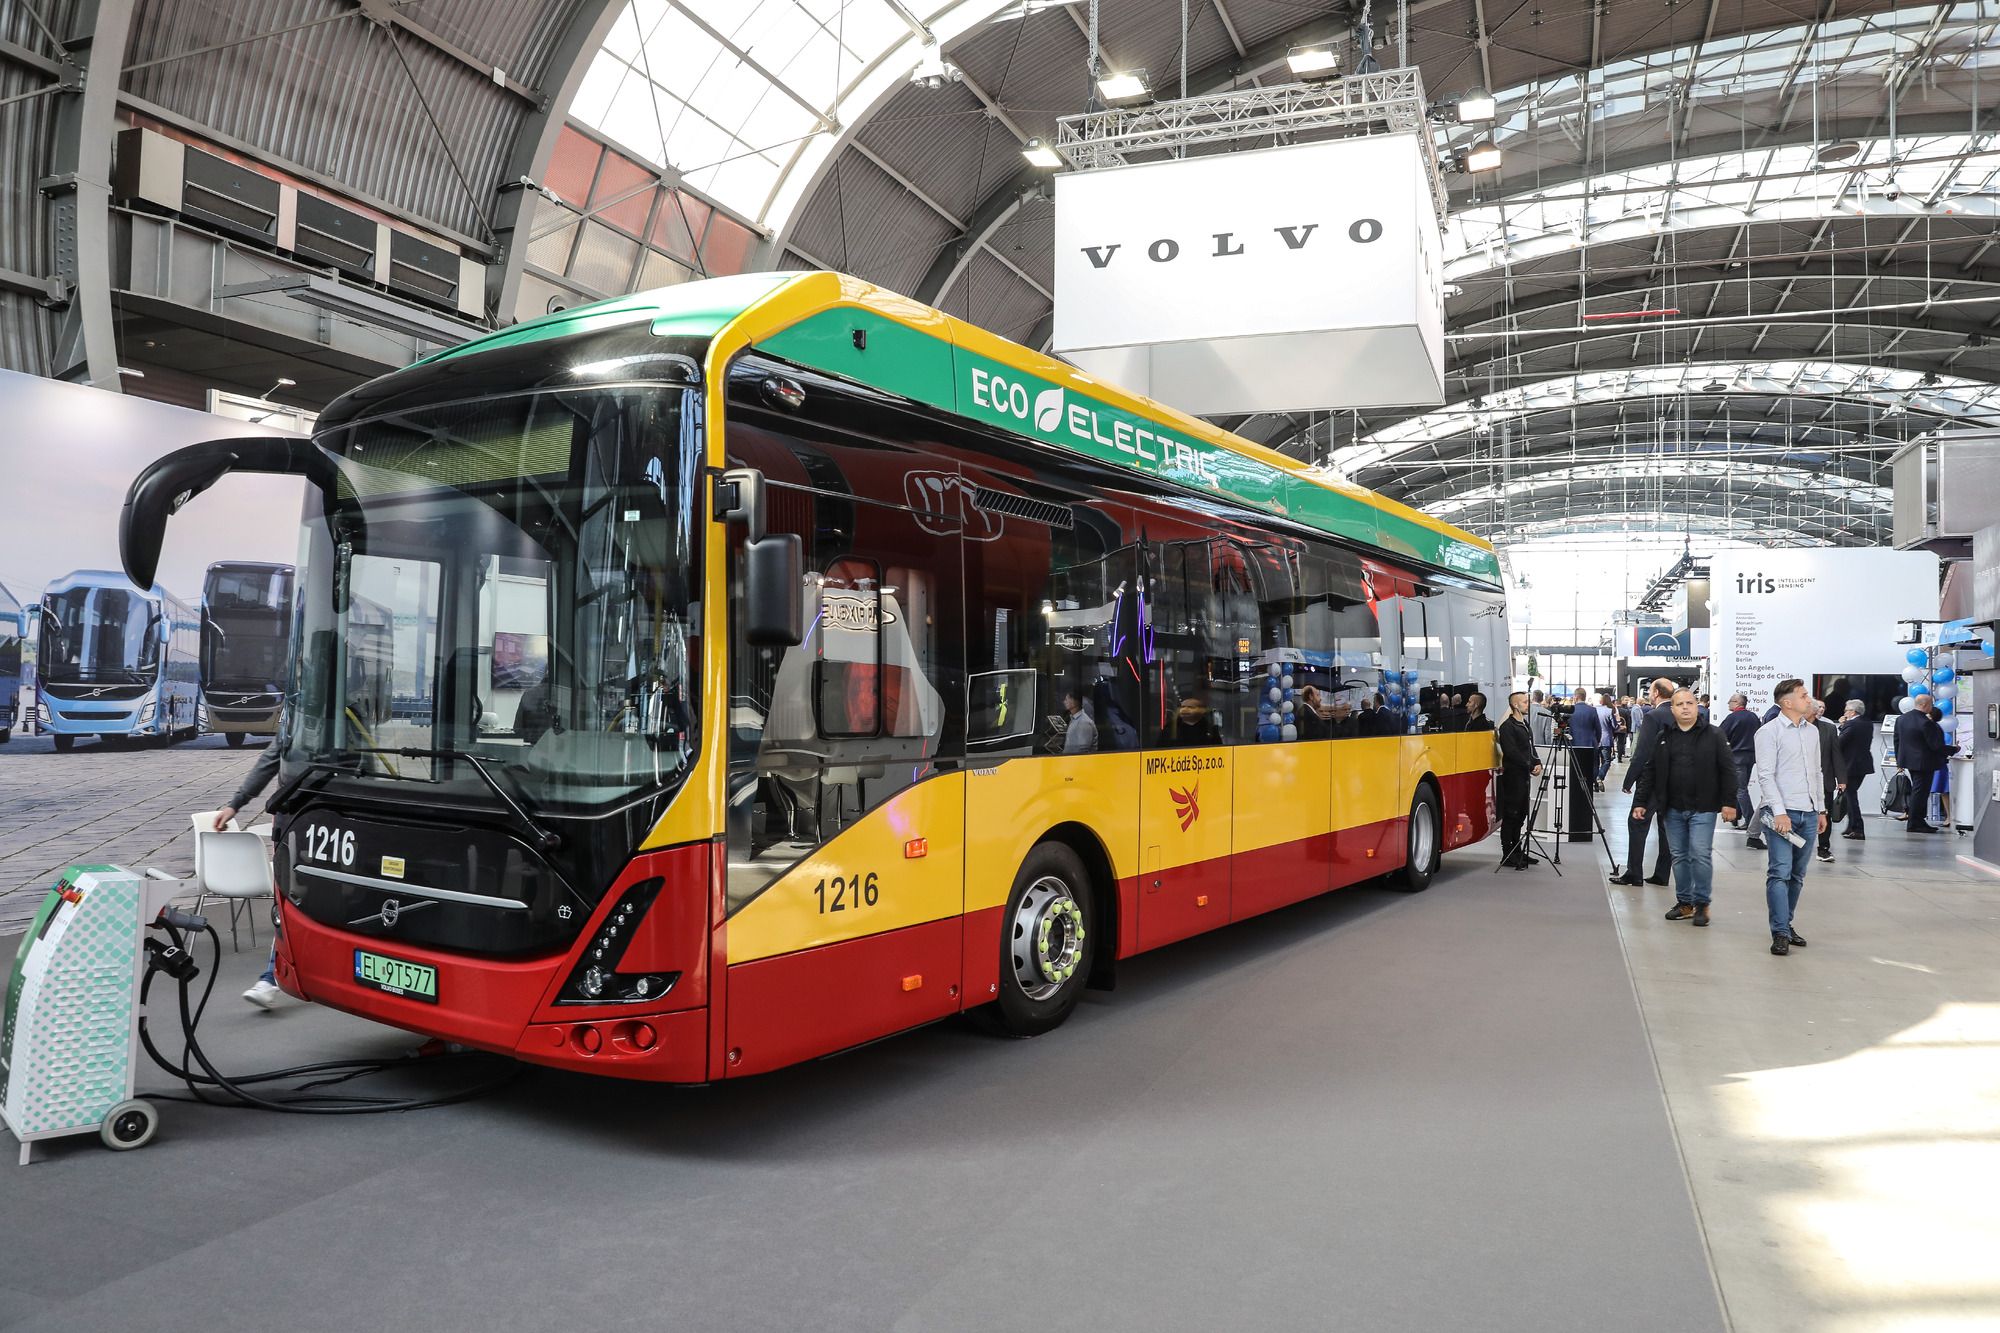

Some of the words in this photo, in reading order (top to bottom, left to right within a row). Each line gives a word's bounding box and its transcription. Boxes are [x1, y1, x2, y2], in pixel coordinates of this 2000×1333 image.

[1080, 218, 1383, 269] VOLVO
[971, 367, 1029, 419] ECO
[1068, 403, 1217, 484] ELECTRIC
[1736, 572, 1776, 594] iris
[1736, 672, 1766, 680] Santiago
[1146, 755, 1191, 775] MPK-Łódź
[1192, 755, 1205, 774] Sp.
[306, 824, 355, 865] 1216
[814, 872, 879, 914] 1216
[364, 955, 380, 981] EL
[386, 961, 432, 992] 9T577
